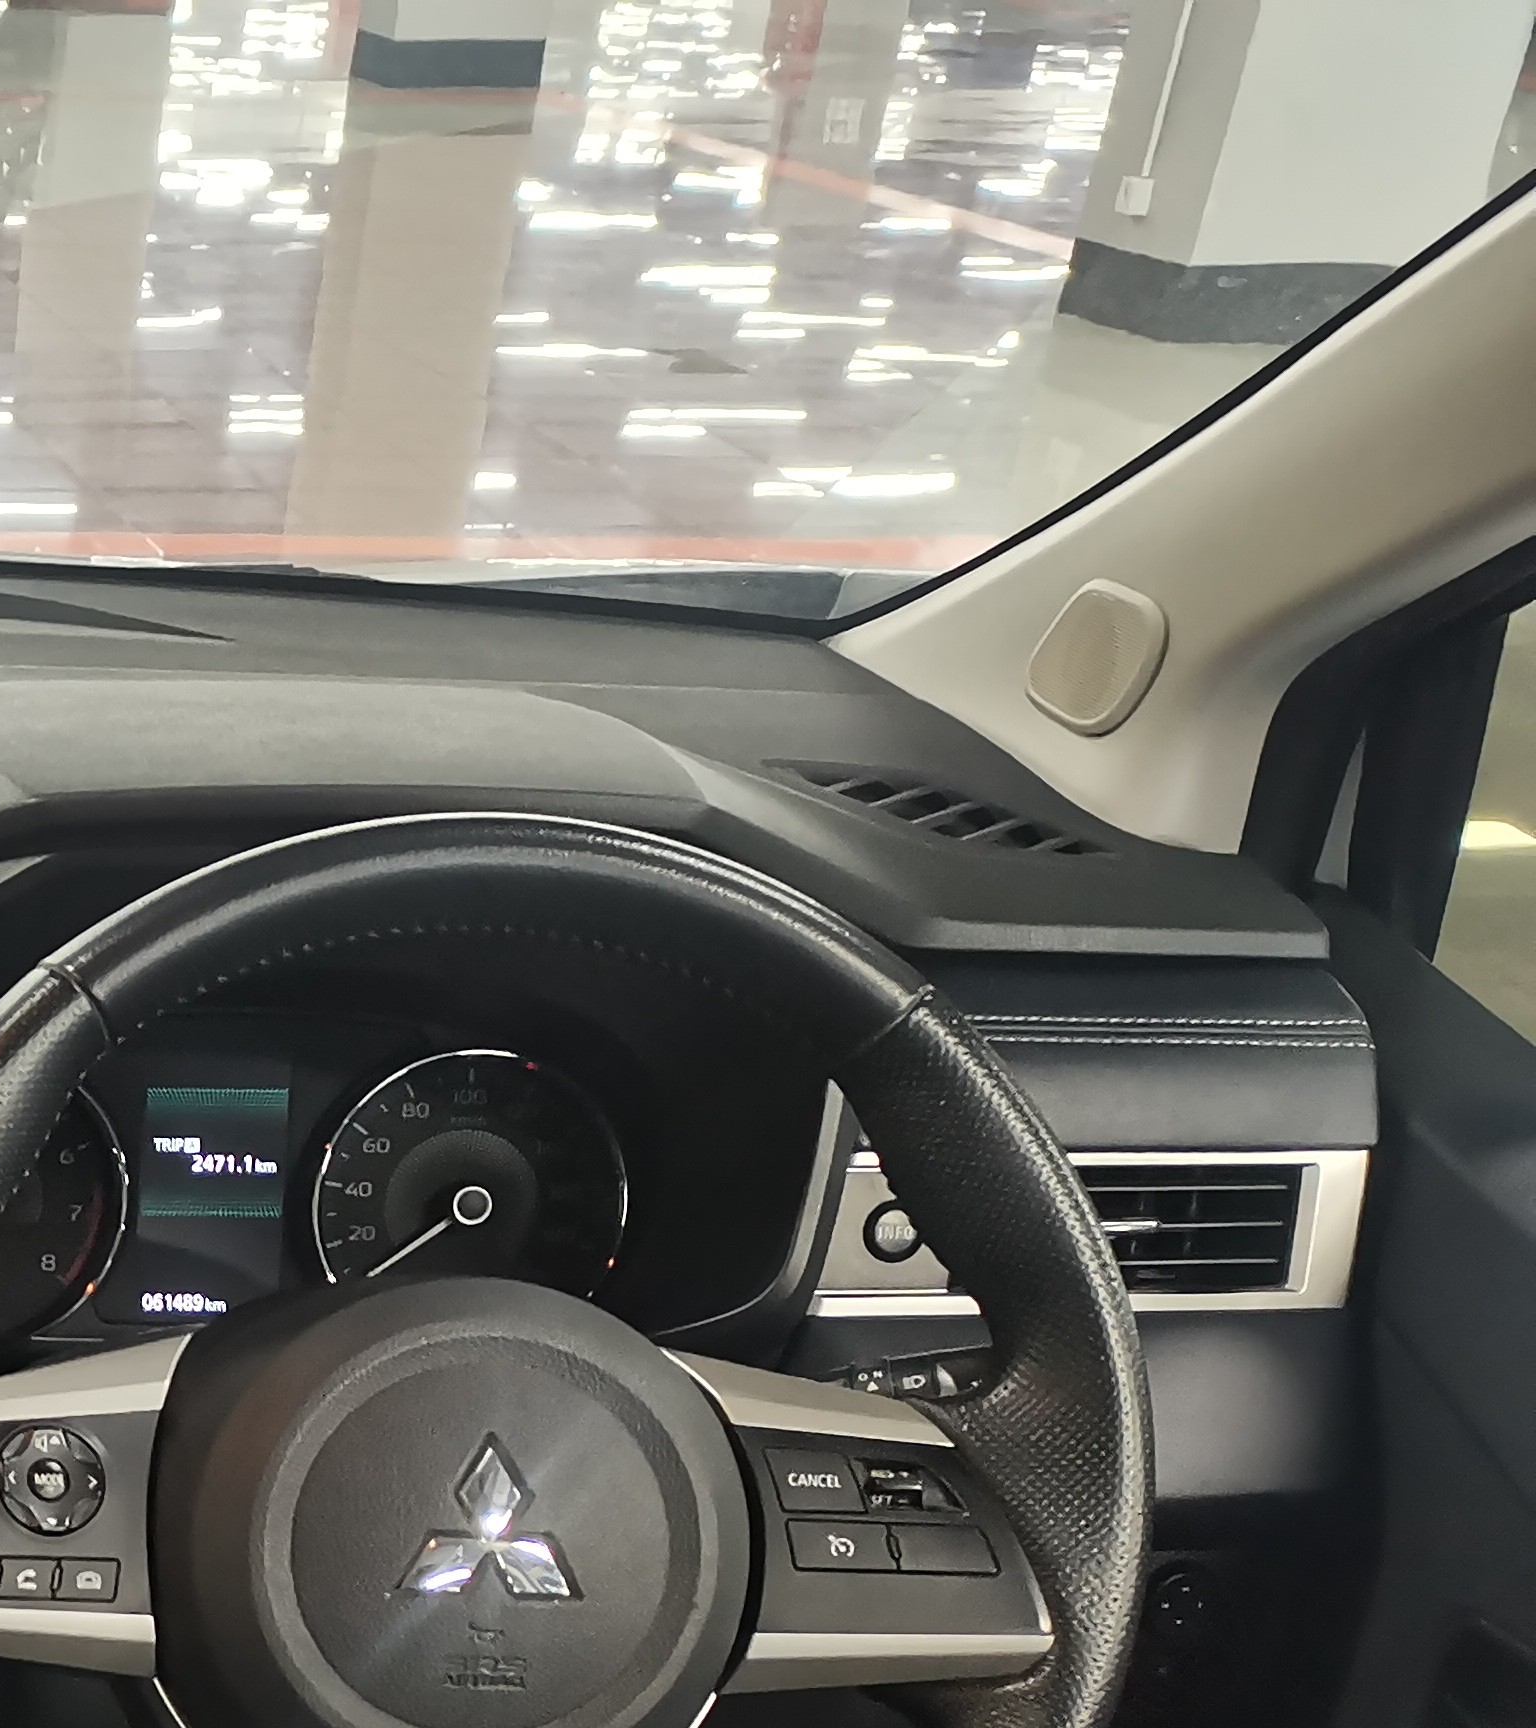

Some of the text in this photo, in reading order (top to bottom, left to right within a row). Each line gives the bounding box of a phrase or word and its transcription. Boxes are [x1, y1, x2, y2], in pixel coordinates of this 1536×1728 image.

[362, 1138, 391, 1153] 60
[345, 1181, 373, 1197] 40
[349, 1225, 376, 1241] 20
[877, 1226, 915, 1240] INFO
[41, 1253, 56, 1272] 8
[788, 1472, 842, 1488] CANCEL
